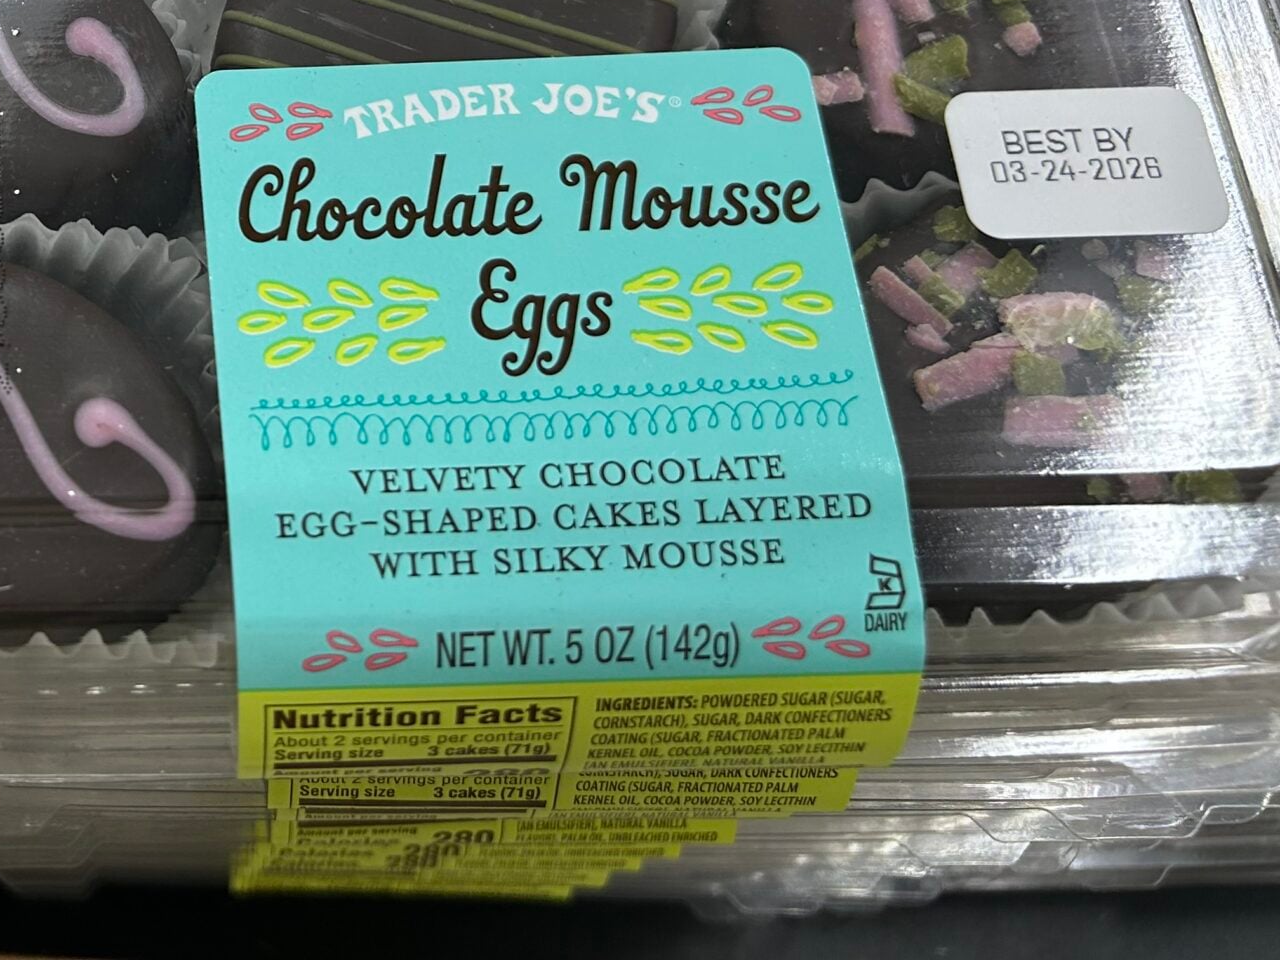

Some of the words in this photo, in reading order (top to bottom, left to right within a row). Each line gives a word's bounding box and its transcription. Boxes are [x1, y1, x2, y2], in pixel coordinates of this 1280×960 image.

[343, 82, 521, 140] TRADER
[1001, 128, 1082, 155] BEST
[1092, 127, 1133, 152] BY
[990, 156, 1163, 183] 03-24-2026
[237, 153, 544, 243] Chocolate
[559, 153, 820, 232] Mousse
[471, 258, 612, 378] Eggs
[349, 465, 527, 495] VELVETY
[539, 454, 785, 489] CHOCOLATE
[275, 506, 538, 539] EGG-SHAPED
[553, 499, 683, 530] CAKES
[695, 492, 873, 525] LAYERED
[371, 551, 479, 580] WITH
[493, 545, 610, 574] SILKY
[621, 538, 784, 570] MOUSSE
[864, 611, 908, 632] DAIRY
[435, 629, 496, 670] NET
[503, 628, 556, 667] WT.
[564, 628, 582, 664] 5
[594, 626, 635, 664] OZ
[643, 622, 740, 669] (142g)
[595, 696, 698, 712] INGREDIENTS:
[700, 694, 778, 709] POWDERED
[782, 692, 828, 706] SUGAR
[830, 690, 886, 706] (SUGAR,
[273, 706, 441, 729] Nutrition
[455, 704, 563, 725] Facts
[593, 714, 688, 729] CORNSTARCH),
[692, 712, 741, 727] SUGAR,
[744, 711, 781, 725] DARK
[784, 708, 892, 724] CONFECTIONERS
[274, 736, 328, 748] About
[334, 735, 345, 746] 2
[351, 734, 430, 748] servings
[439, 733, 468, 746] per
[474, 730, 562, 743] container
[590, 732, 647, 746] COATING
[650, 730, 703, 745] (SUGAR,
[706, 728, 805, 742] FRACTIONATED
[807, 727, 846, 739] PALM
[274, 749, 343, 761] Serving
[348, 747, 384, 758] size
[428, 745, 438, 757] 3
[444, 744, 501, 756] cakes
[504, 743, 550, 757] (71g)
